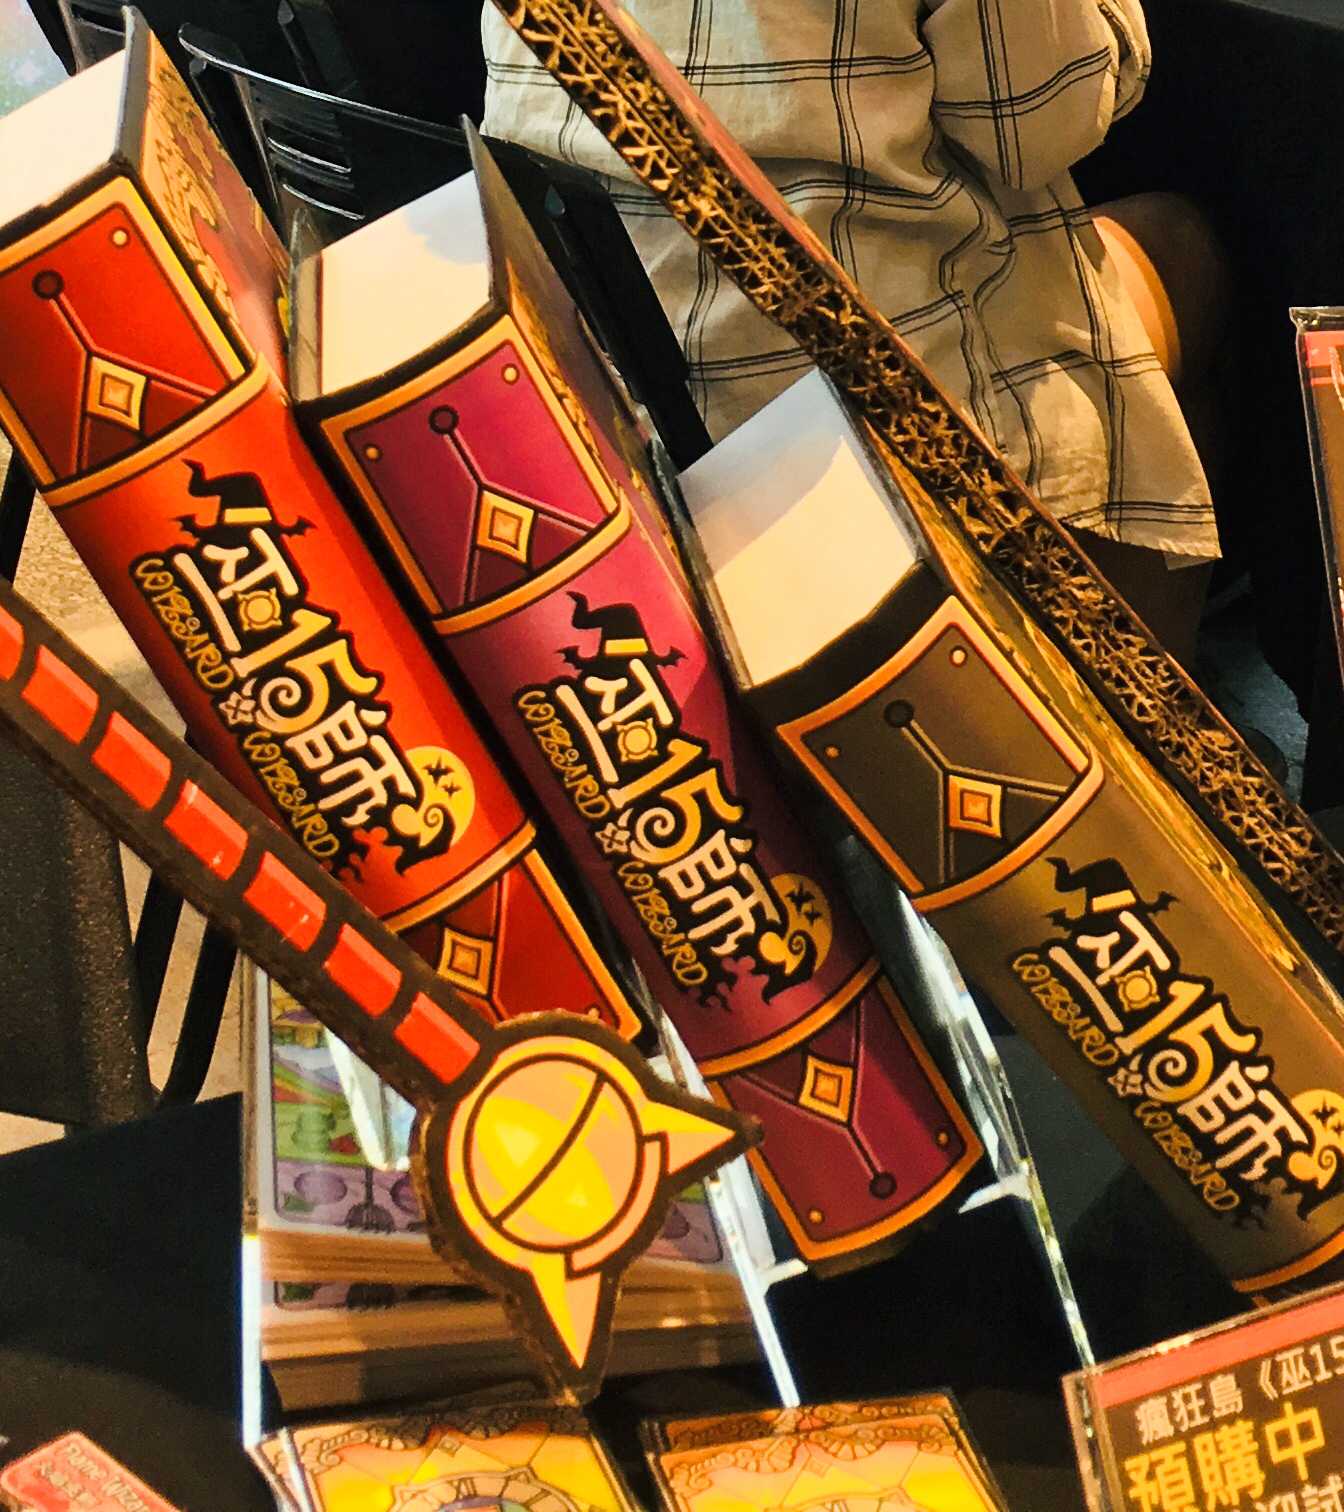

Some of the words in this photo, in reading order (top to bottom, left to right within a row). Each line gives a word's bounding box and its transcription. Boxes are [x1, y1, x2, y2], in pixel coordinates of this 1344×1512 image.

[136, 558, 235, 696] WIZARD
[241, 731, 342, 859] WIZARD
[513, 687, 614, 823] WIZARD
[616, 857, 710, 989] WIZARD
[1012, 951, 1120, 1067] WIZARD
[1135, 1093, 1241, 1215] WIZARD
[1123, 1400, 1328, 1512] 預購中
